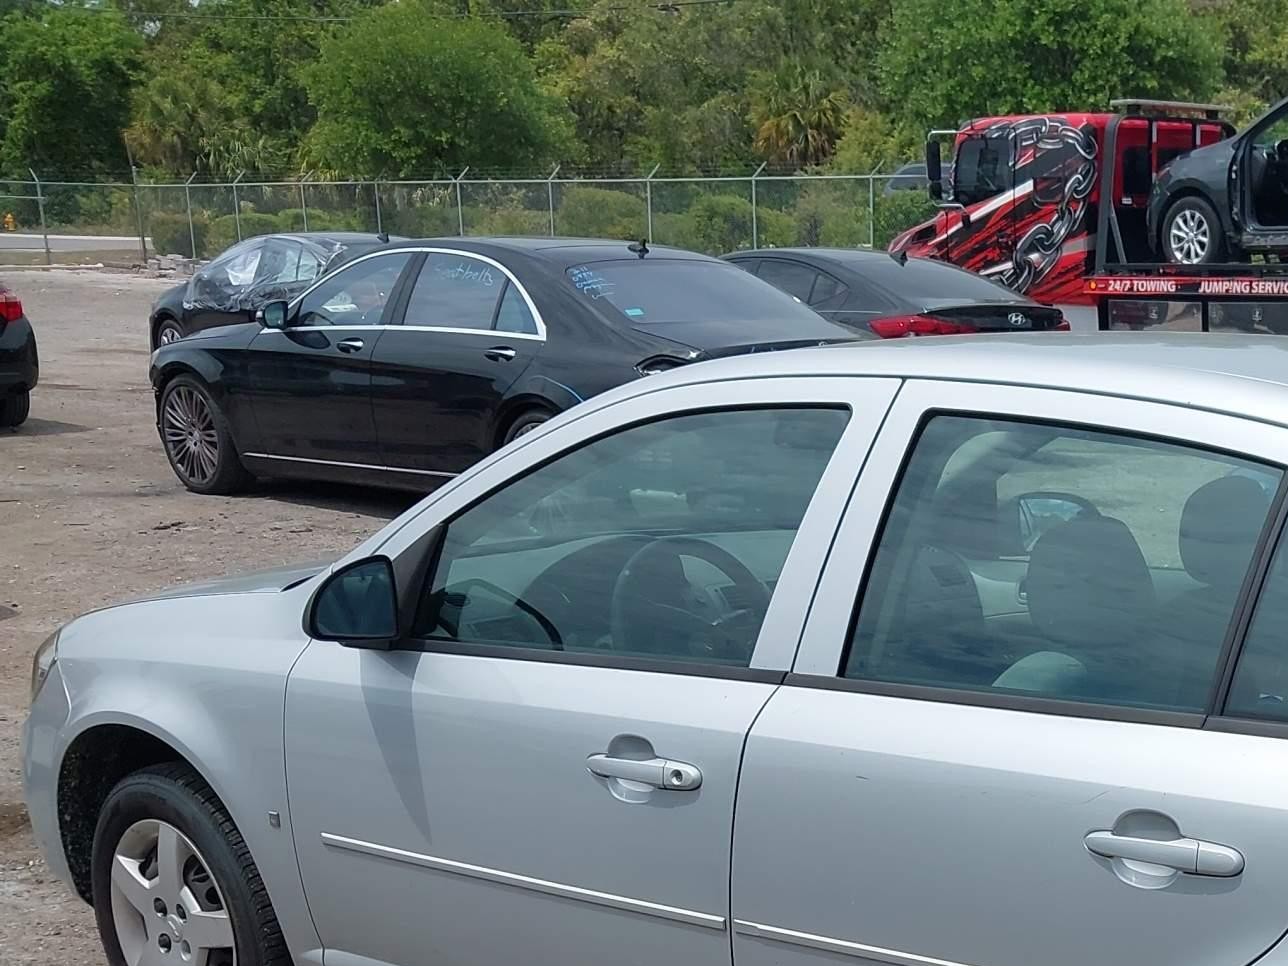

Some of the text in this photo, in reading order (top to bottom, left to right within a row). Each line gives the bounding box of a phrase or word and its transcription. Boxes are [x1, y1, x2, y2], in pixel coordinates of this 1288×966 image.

[1108, 280, 1176, 293] 24/7 TOWING
[1198, 281, 1250, 294] JUMPING
